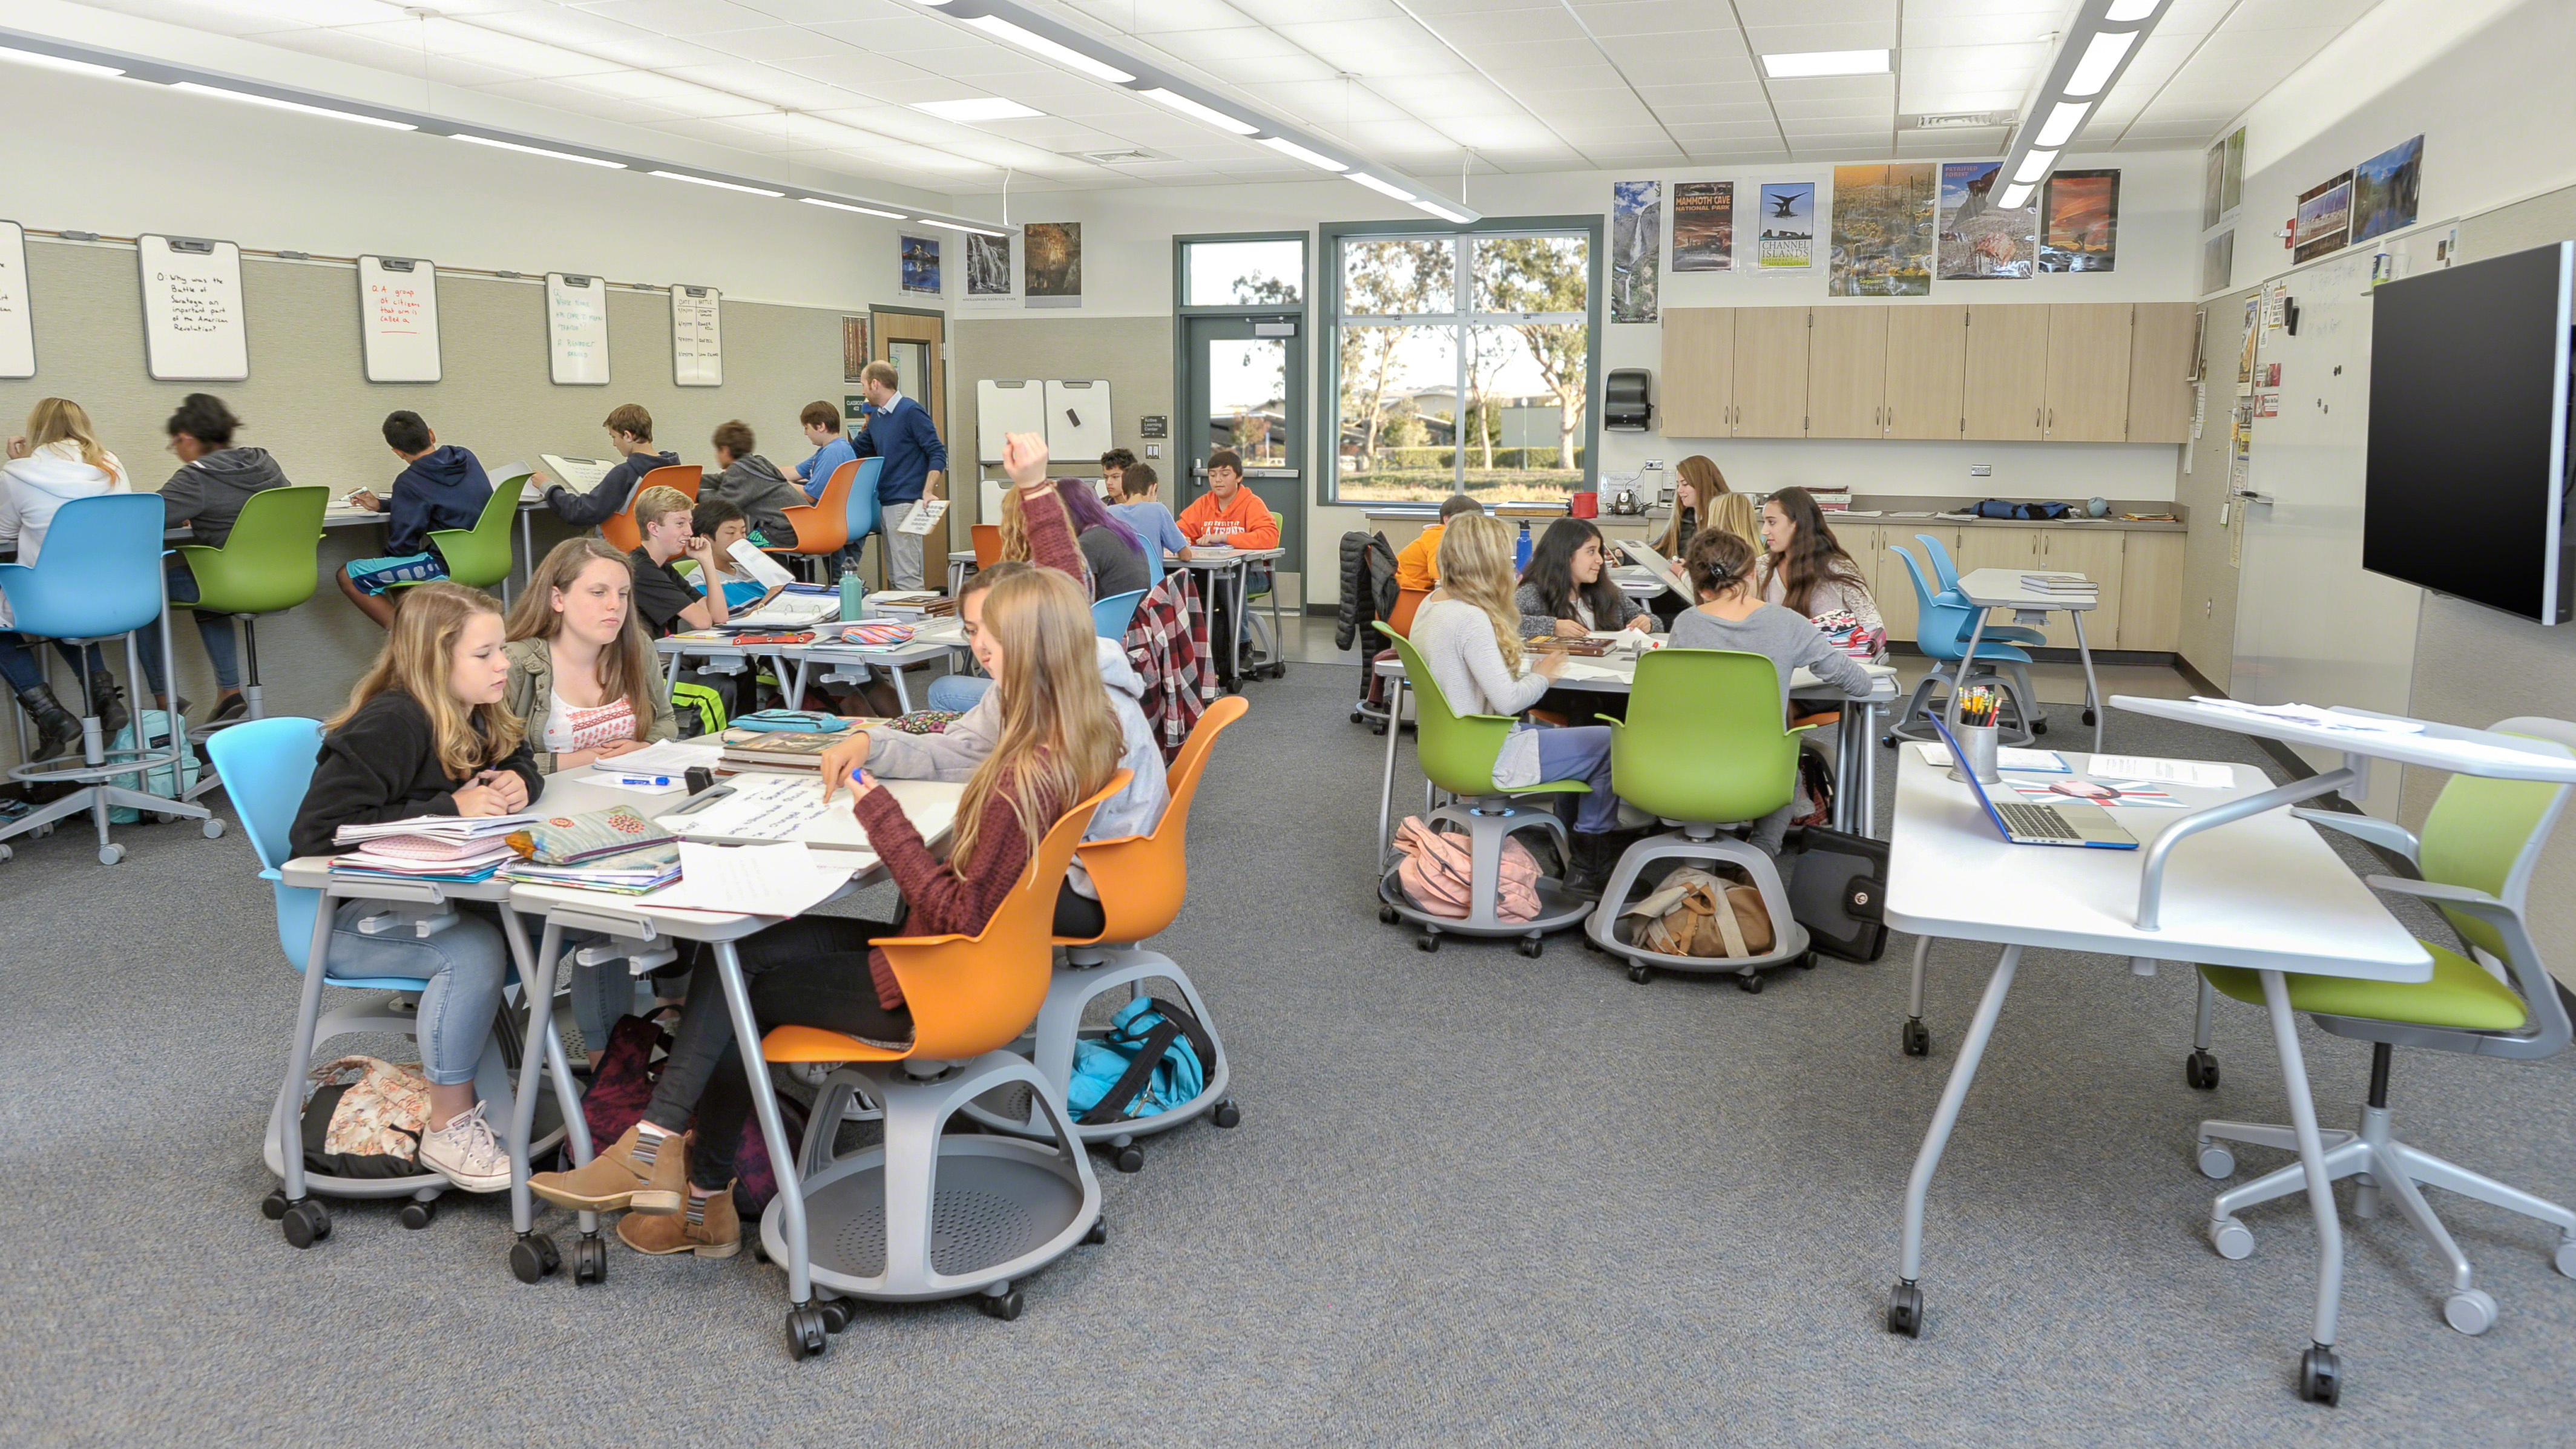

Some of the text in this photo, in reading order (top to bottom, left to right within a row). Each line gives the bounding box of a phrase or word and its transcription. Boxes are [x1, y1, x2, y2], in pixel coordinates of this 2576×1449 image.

[1675, 195, 1731, 206] MAMMOTH CAVE
[1762, 240, 1809, 250] CHANNEL
[1762, 249, 1809, 258] ISLANDS
[169, 275, 187, 284] Why
[171, 295, 203, 307] Saratoga
[393, 298, 420, 307] citizens
